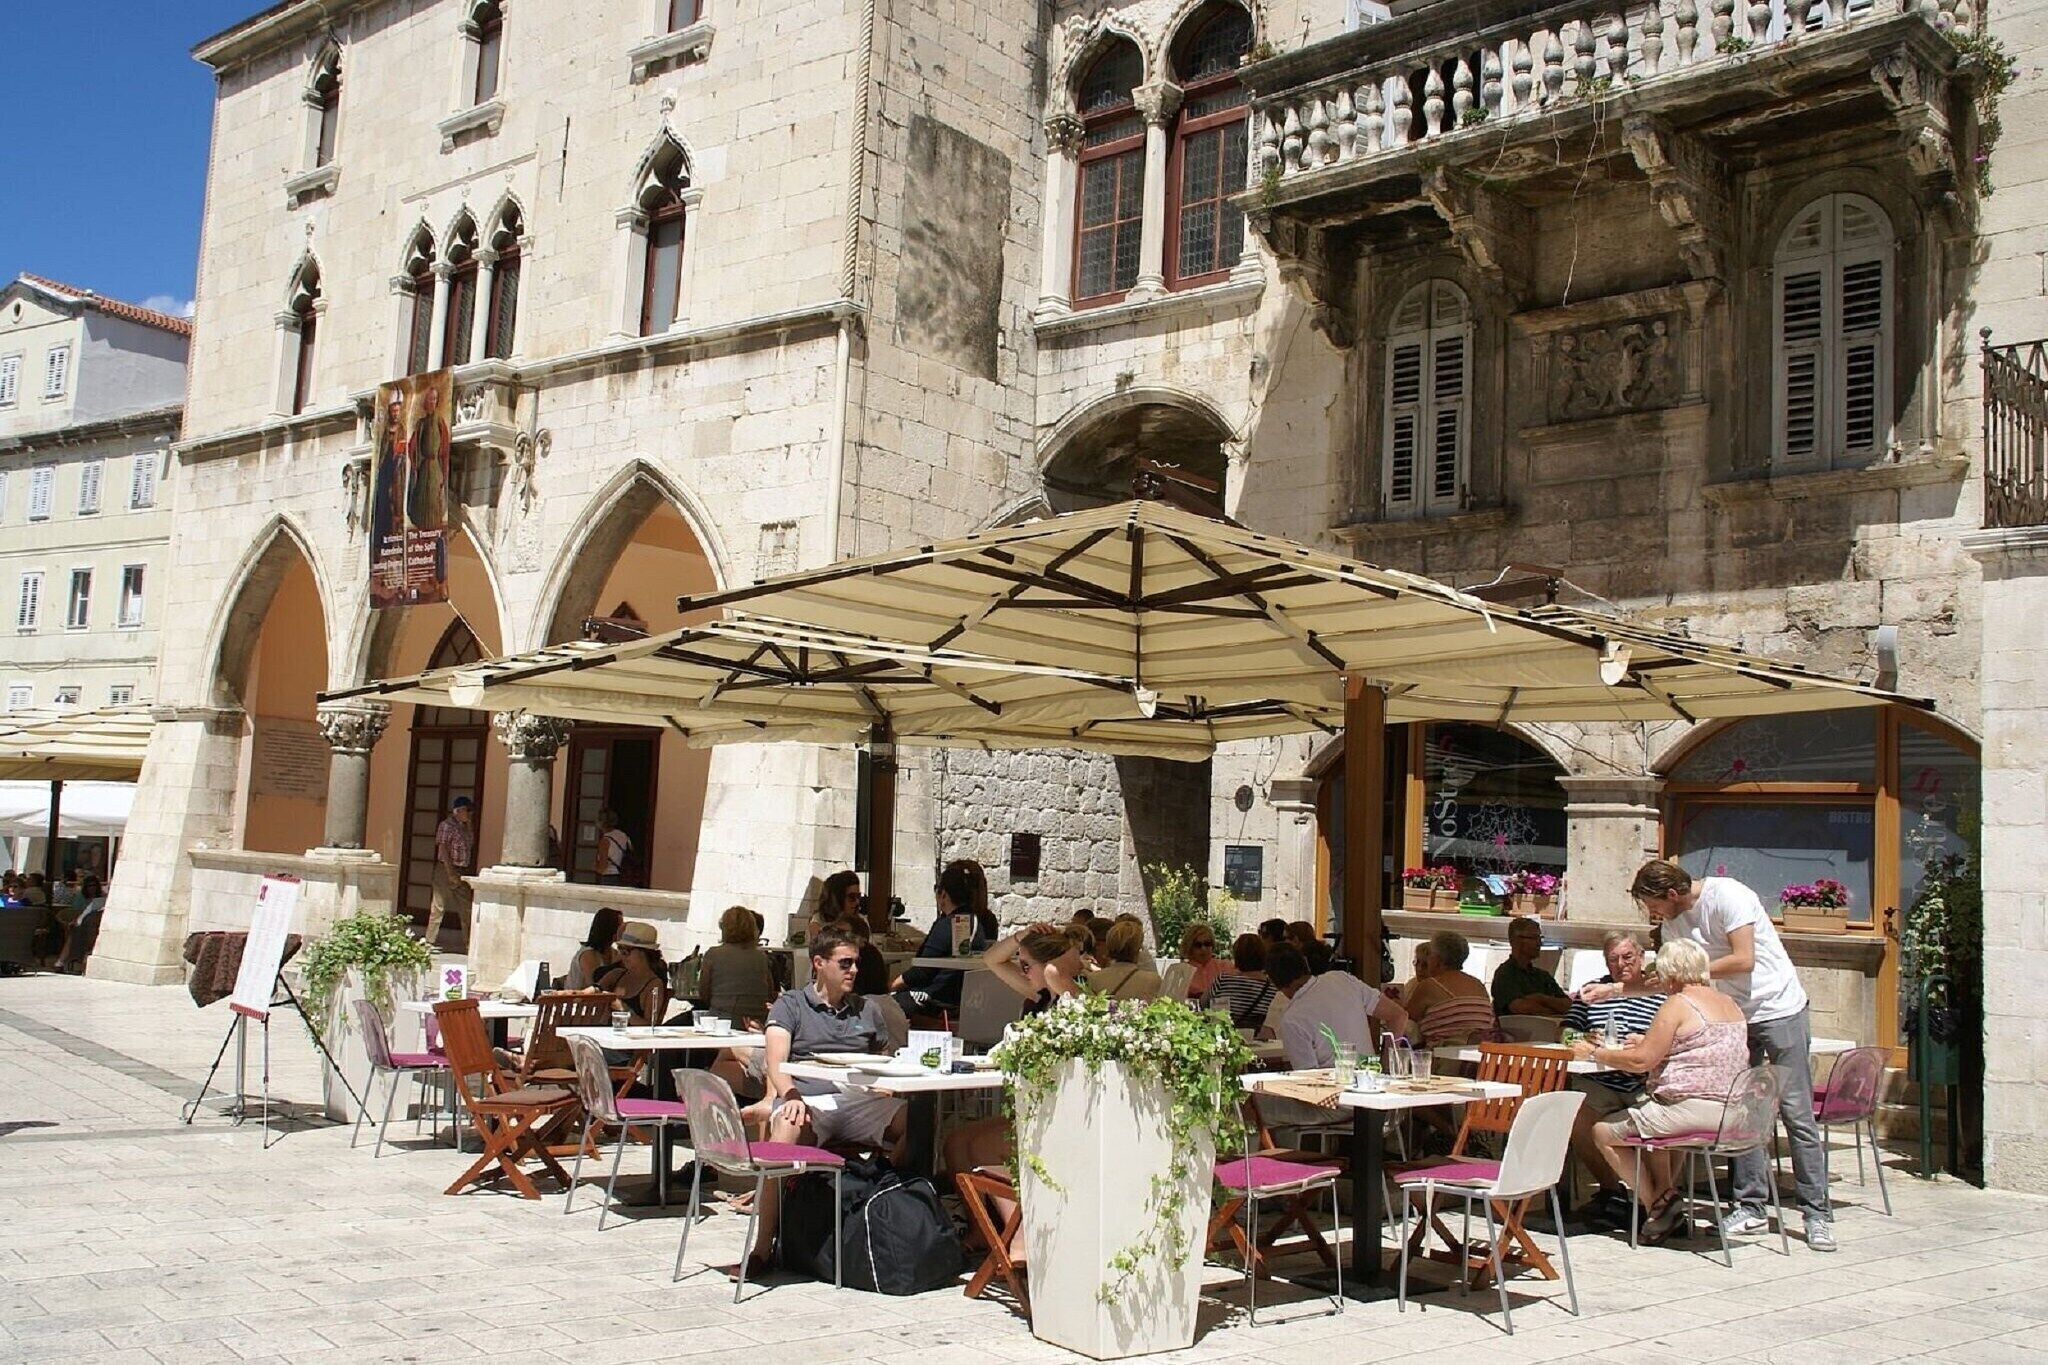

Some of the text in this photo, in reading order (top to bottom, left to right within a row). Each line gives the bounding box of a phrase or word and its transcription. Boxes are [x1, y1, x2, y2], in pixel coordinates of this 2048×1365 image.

[408, 531, 418, 540] The
[419, 529, 442, 539] Treasury
[408, 541, 437, 552] of the Split
